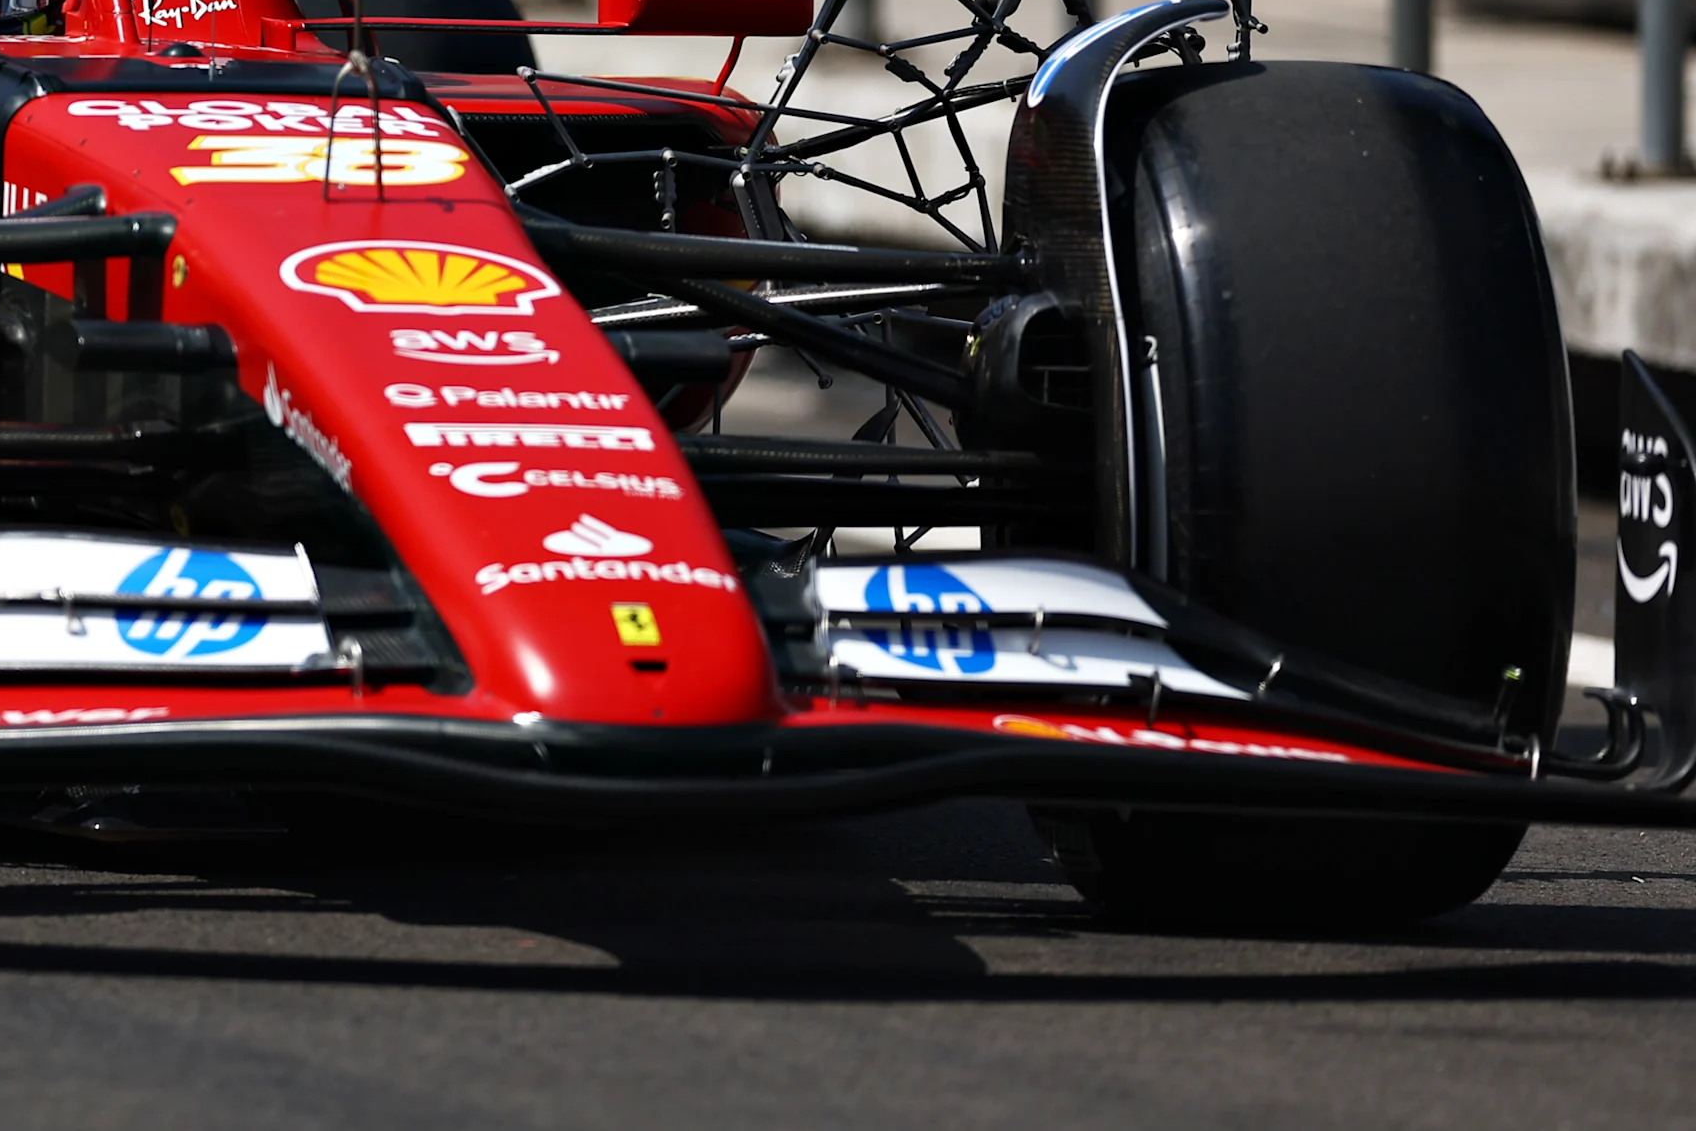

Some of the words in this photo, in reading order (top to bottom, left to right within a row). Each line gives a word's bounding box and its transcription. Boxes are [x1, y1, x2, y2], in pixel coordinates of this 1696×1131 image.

[67, 99, 451, 125] GLOBAL
[117, 114, 440, 137] POKER
[170, 135, 470, 187] 38
[390, 329, 547, 355] aws
[439, 385, 630, 410] Palantir
[404, 422, 655, 452] PIRELLI
[524, 469, 682, 496] CELSIUS
[474, 557, 740, 595] Santander
[118, 547, 268, 657] hp
[864, 564, 996, 674] hp
